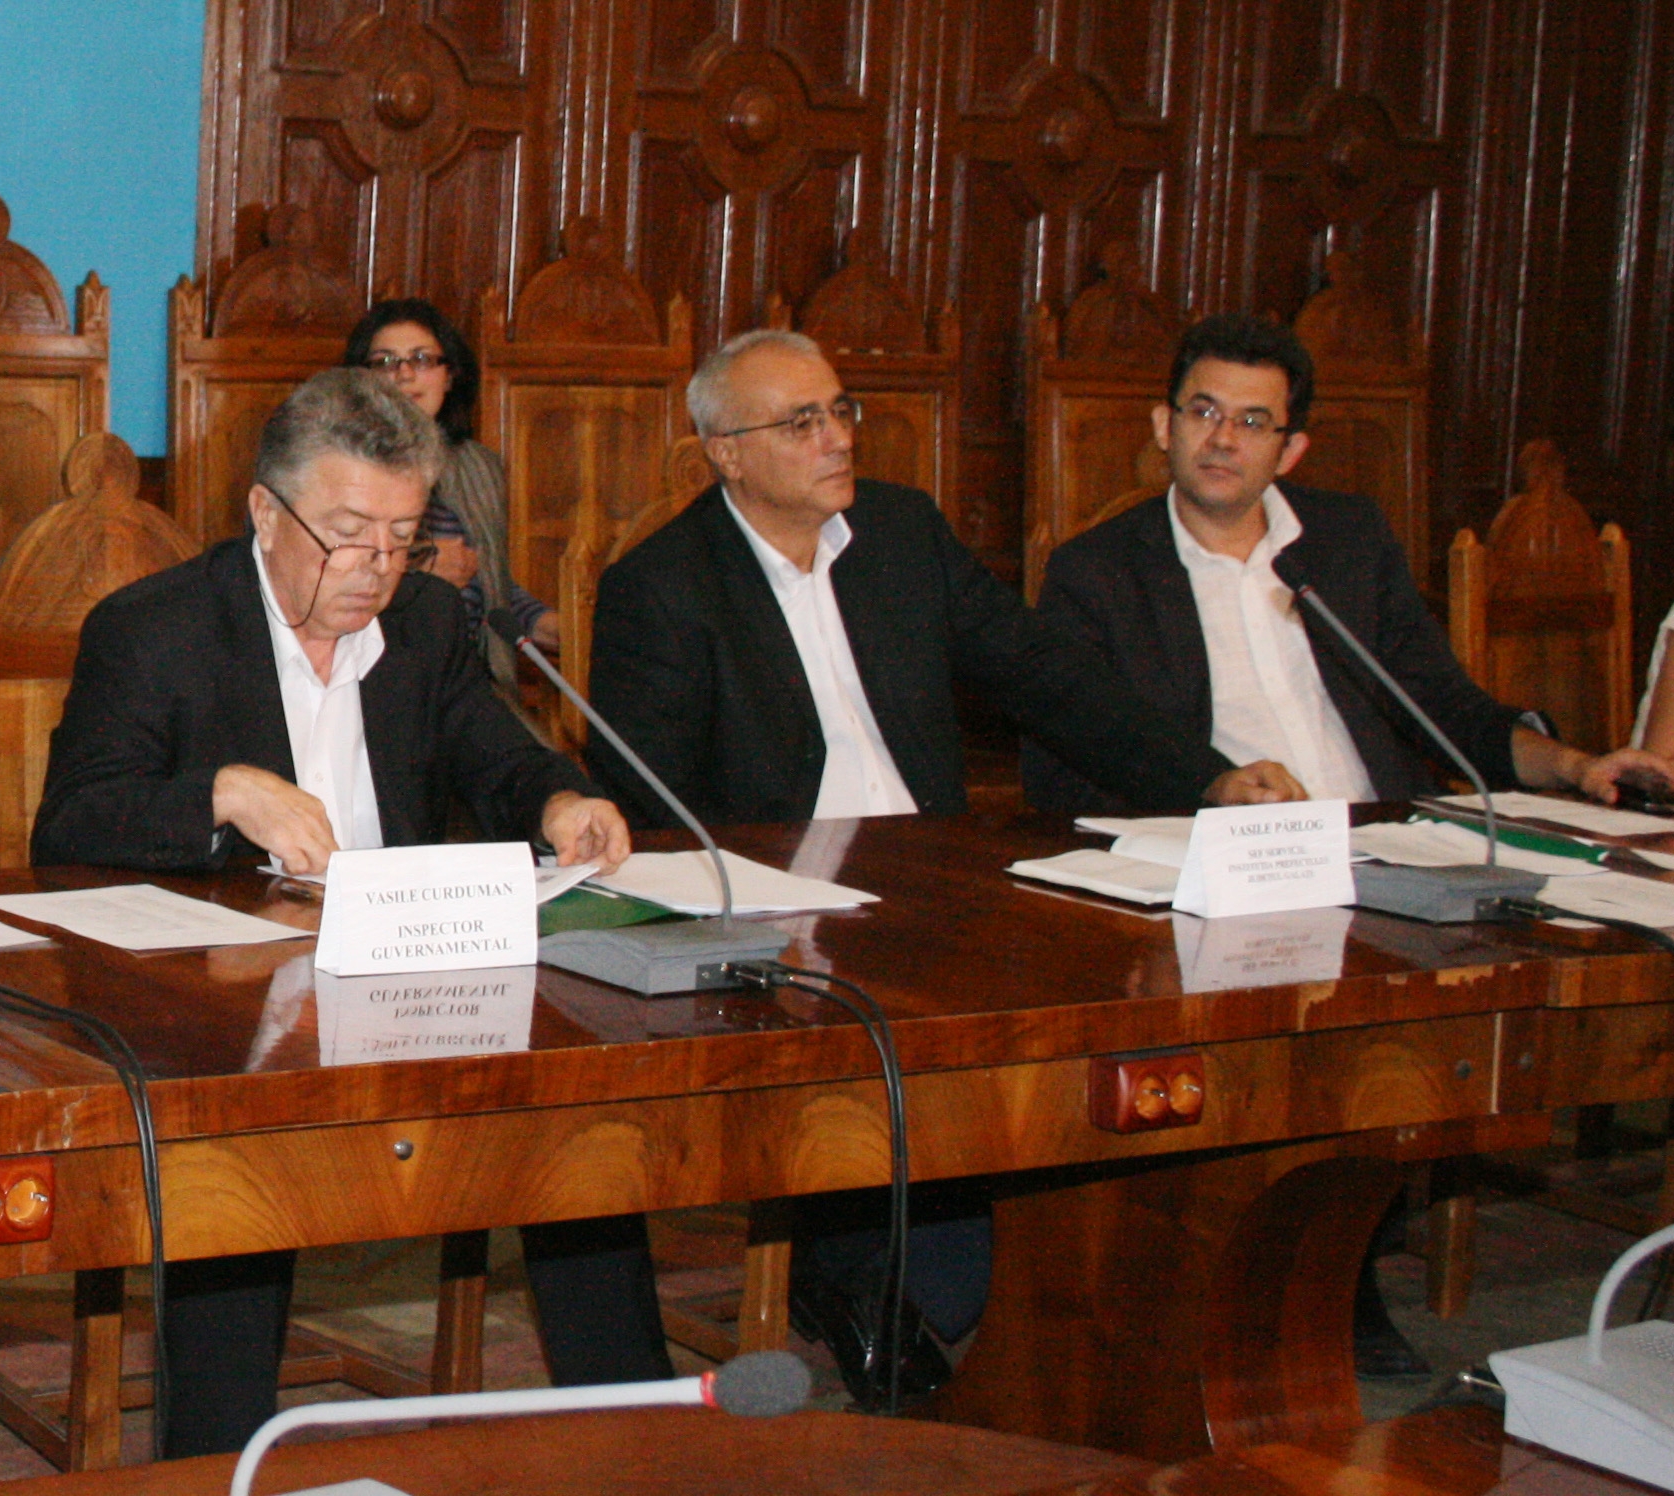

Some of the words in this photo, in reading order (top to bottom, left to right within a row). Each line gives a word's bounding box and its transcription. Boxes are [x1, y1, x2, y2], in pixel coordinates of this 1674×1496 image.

[1229, 823, 1271, 836] VASILE
[366, 889, 418, 905] VASILE
[421, 882, 514, 901] CURDUMAN
[398, 920, 485, 938] INSPECTOR
[371, 938, 512, 960] GUVERNAMENTAL
